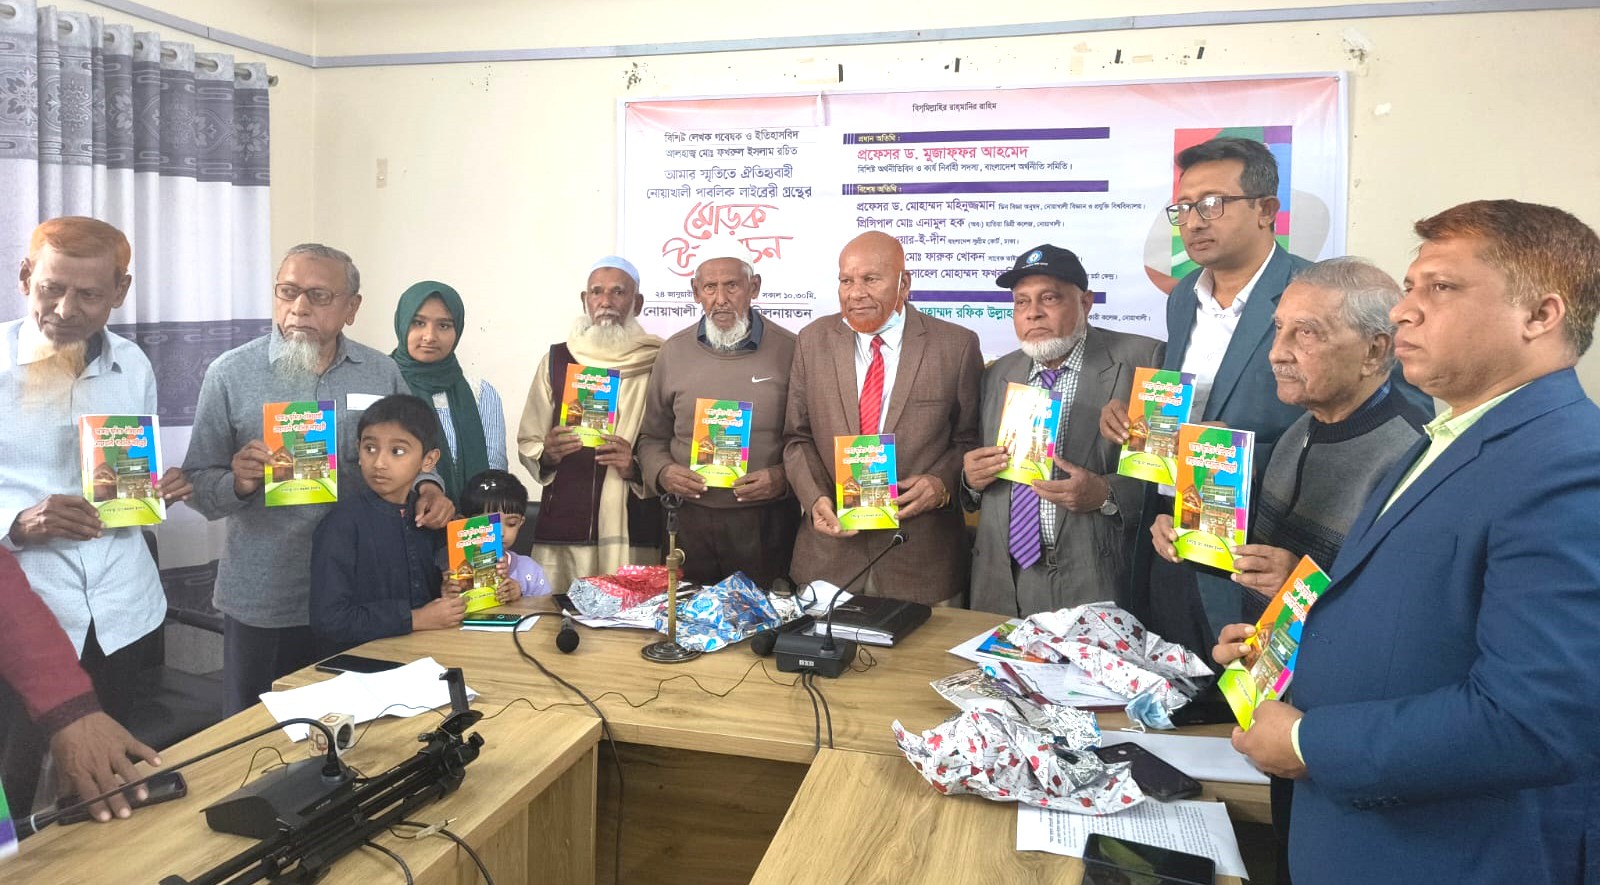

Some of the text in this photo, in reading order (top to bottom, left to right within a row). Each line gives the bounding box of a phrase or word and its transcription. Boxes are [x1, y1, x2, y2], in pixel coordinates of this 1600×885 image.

[688, 132, 712, 142] লেখক
[715, 132, 742, 142] গবেষক
[755, 128, 799, 140] ইতিহাসবিদ
[717, 147, 744, 157] ফখরুল
[747, 146, 774, 156] ইসলাম
[777, 144, 798, 156] রচিত
[857, 148, 901, 161] প্রফেসর
[904, 148, 918, 160] ড.
[981, 145, 1030, 159] আহমেদ
[664, 163, 793, 182] আমার স্মৃতিতে ঐতিহ্যবাহী
[646, 182, 812, 199] নোয়াখালী পাবলিক লাইব্রেরী গ্রন্থের
[856, 201, 889, 212] প্রফেসর
[906, 200, 944, 211] মোহাম্মদ
[684, 201, 779, 240] মোড়ক
[896, 219, 913, 228] মোঃ
[916, 218, 947, 230] এনামুল
[949, 217, 965, 228] হক
[905, 251, 922, 262] মোঃ
[925, 251, 953, 262] ফারুক
[956, 251, 986, 262] খোকন
[940, 267, 978, 279] মোহাম্মদ
[643, 304, 697, 317] নোয়াখালী
[956, 304, 983, 319] রফিক
